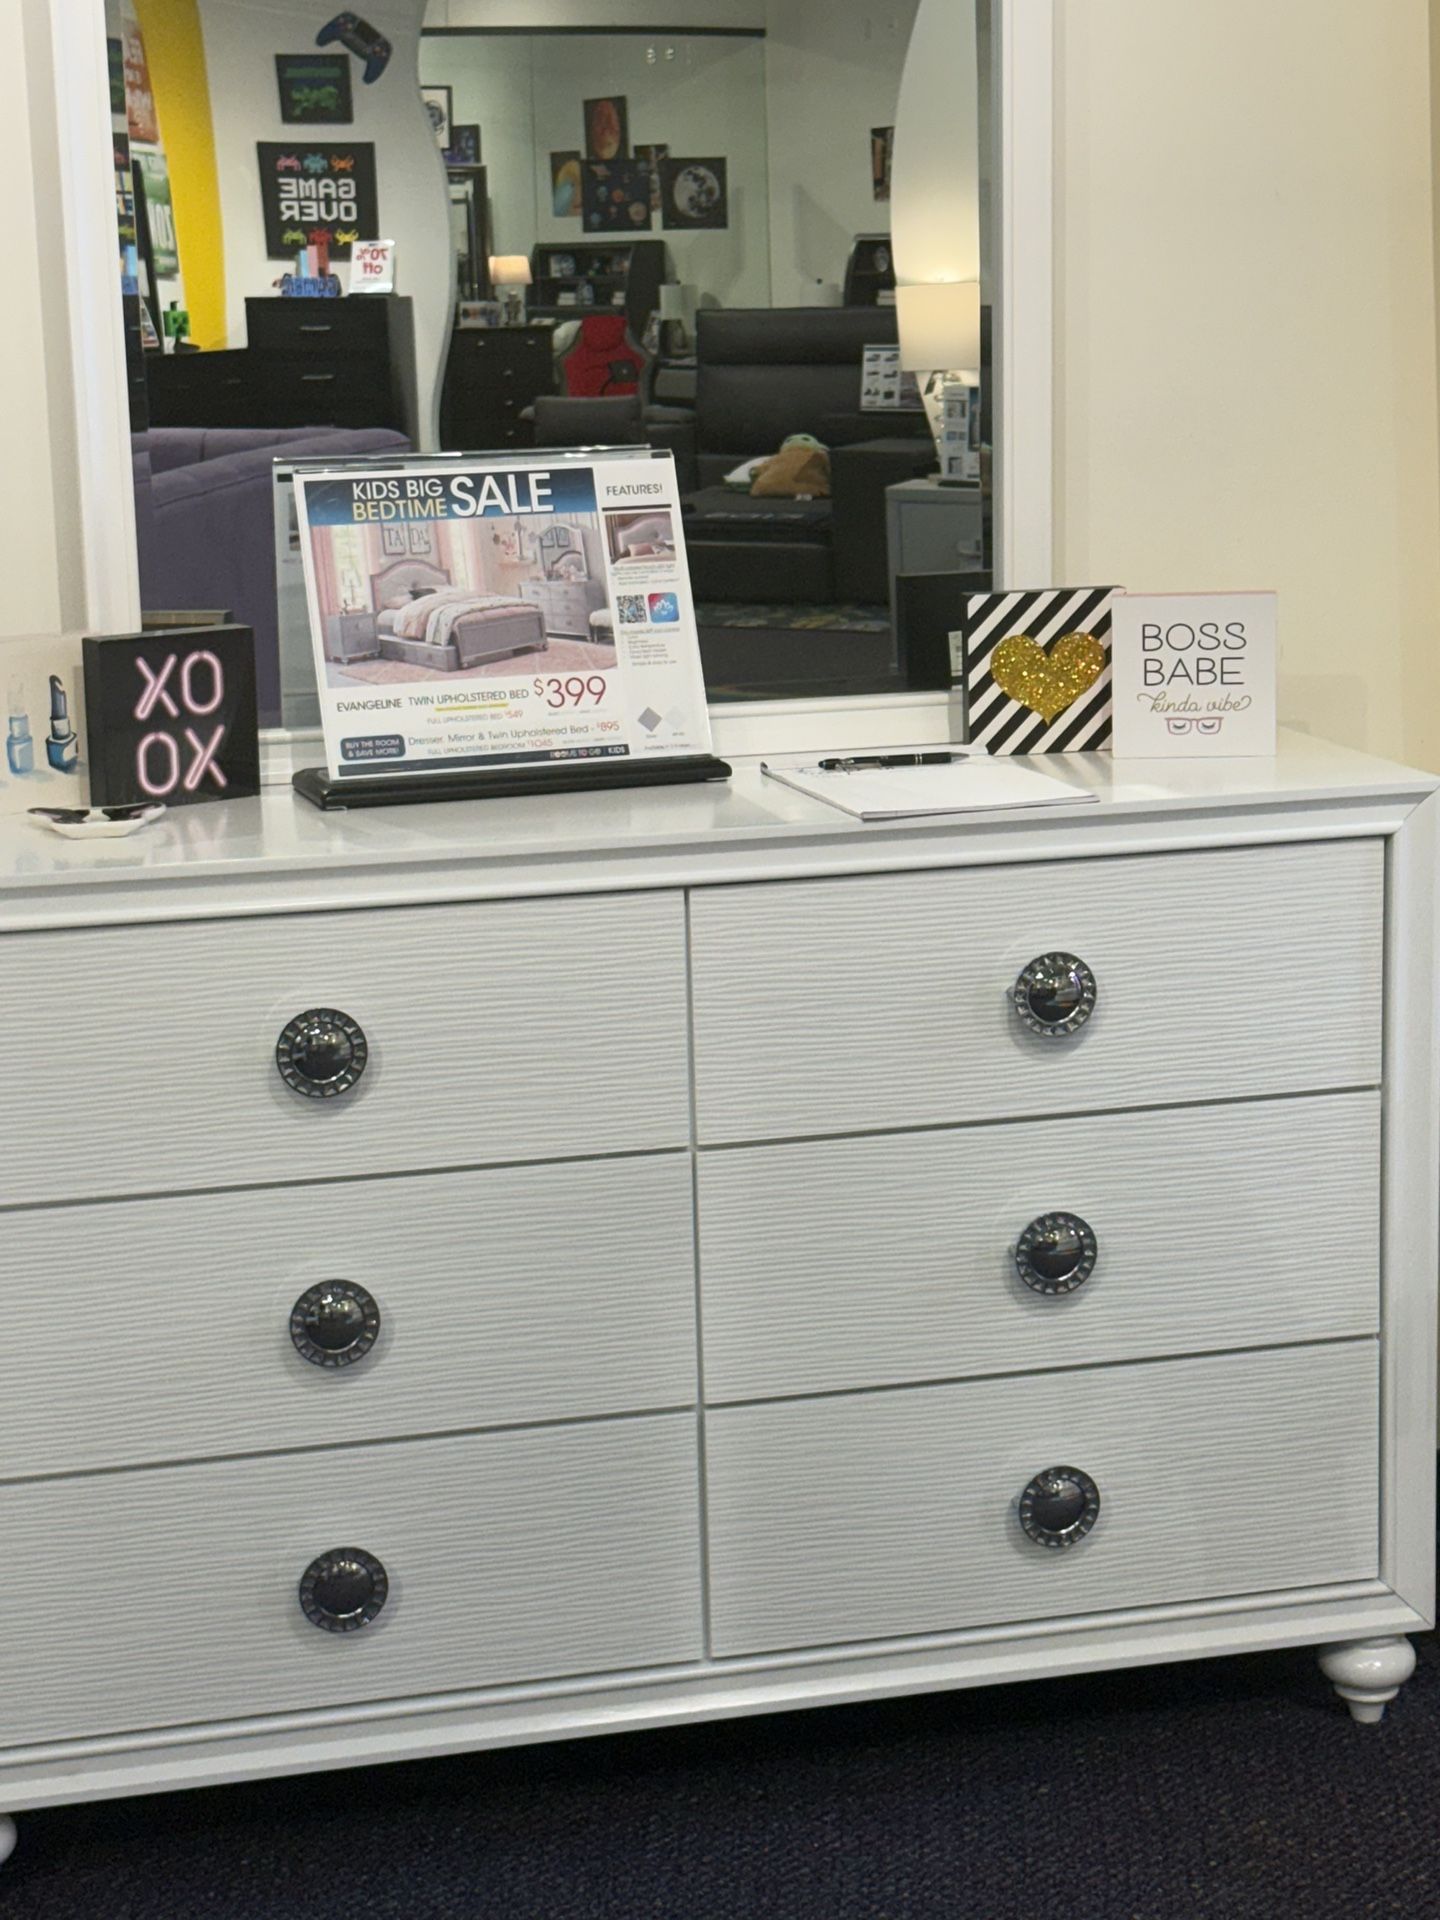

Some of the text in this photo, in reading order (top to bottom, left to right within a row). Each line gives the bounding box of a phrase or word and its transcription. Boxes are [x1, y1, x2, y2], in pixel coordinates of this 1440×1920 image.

[352, 472, 554, 517] KIDS BIG SALE
[606, 483, 663, 496] FEATURES!
[352, 498, 448, 521] BEDTIME
[1141, 622, 1248, 652] BOSS
[134, 650, 224, 721] XO
[1143, 656, 1246, 687] BABE
[336, 675, 607, 712] EVANGELINE TWIN UPHOLSTERED BED $399
[1136, 690, 1252, 713] kinda vibe
[447, 733, 475, 744] Mirror
[478, 732, 485, 740] &
[488, 730, 509, 739] Twin
[510, 726, 568, 740] Upholstered
[569, 725, 589, 734] Bed
[136, 724, 228, 795] OX
